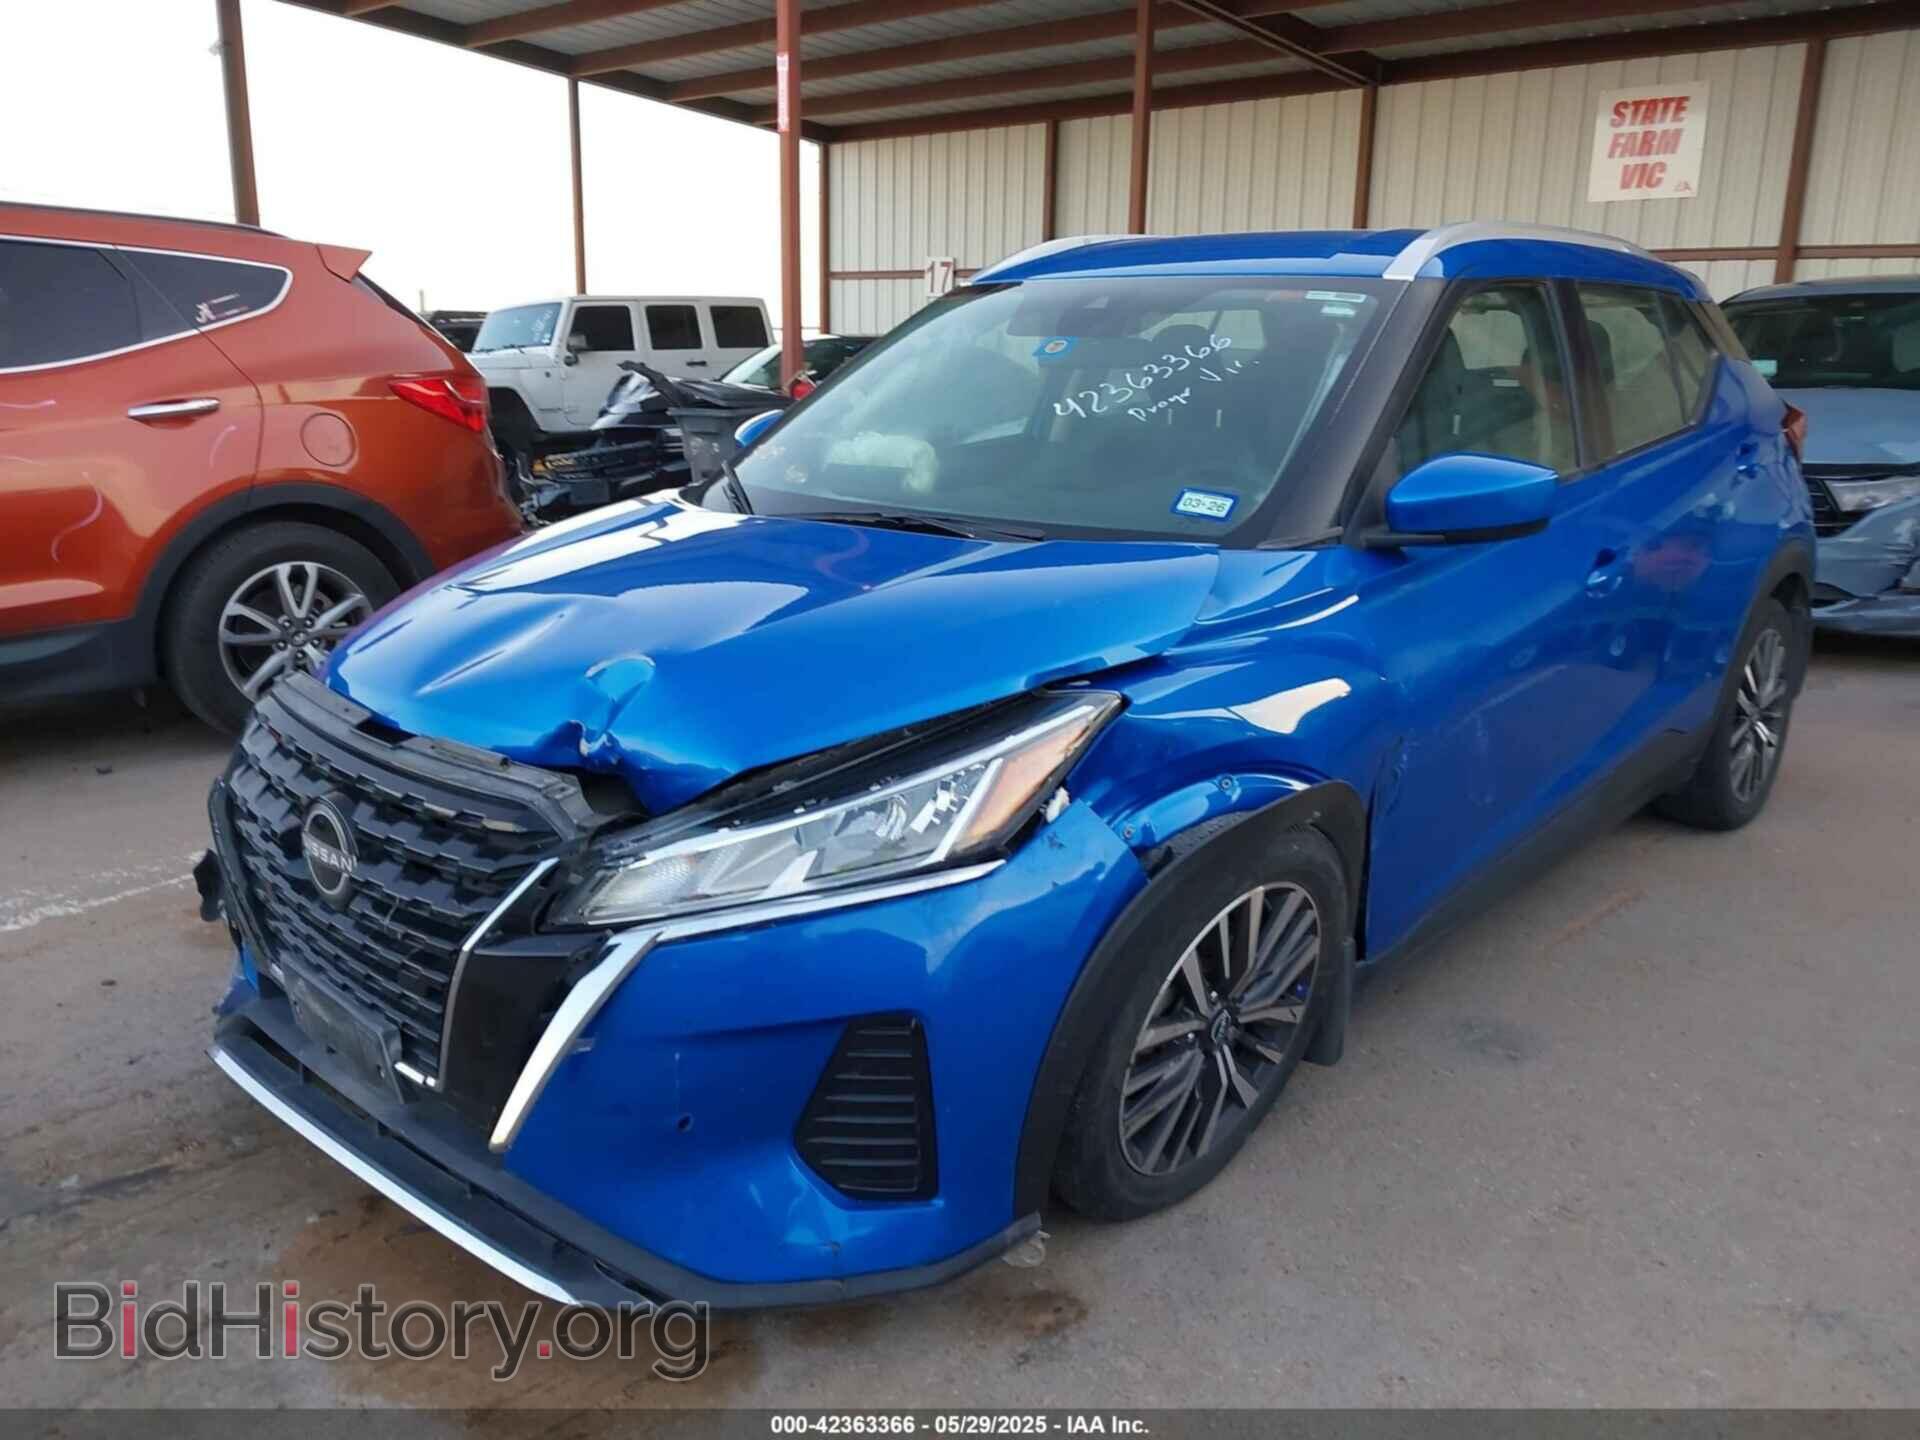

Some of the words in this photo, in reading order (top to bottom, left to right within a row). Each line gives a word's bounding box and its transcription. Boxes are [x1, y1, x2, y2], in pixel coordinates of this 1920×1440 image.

[1609, 95, 1691, 128] STATE
[1607, 128, 1685, 159] FARM
[1619, 161, 1667, 190] VIC
[927, 260, 953, 294] 17
[1053, 333, 1232, 419] 42363366
[303, 836, 353, 873] SSAN
